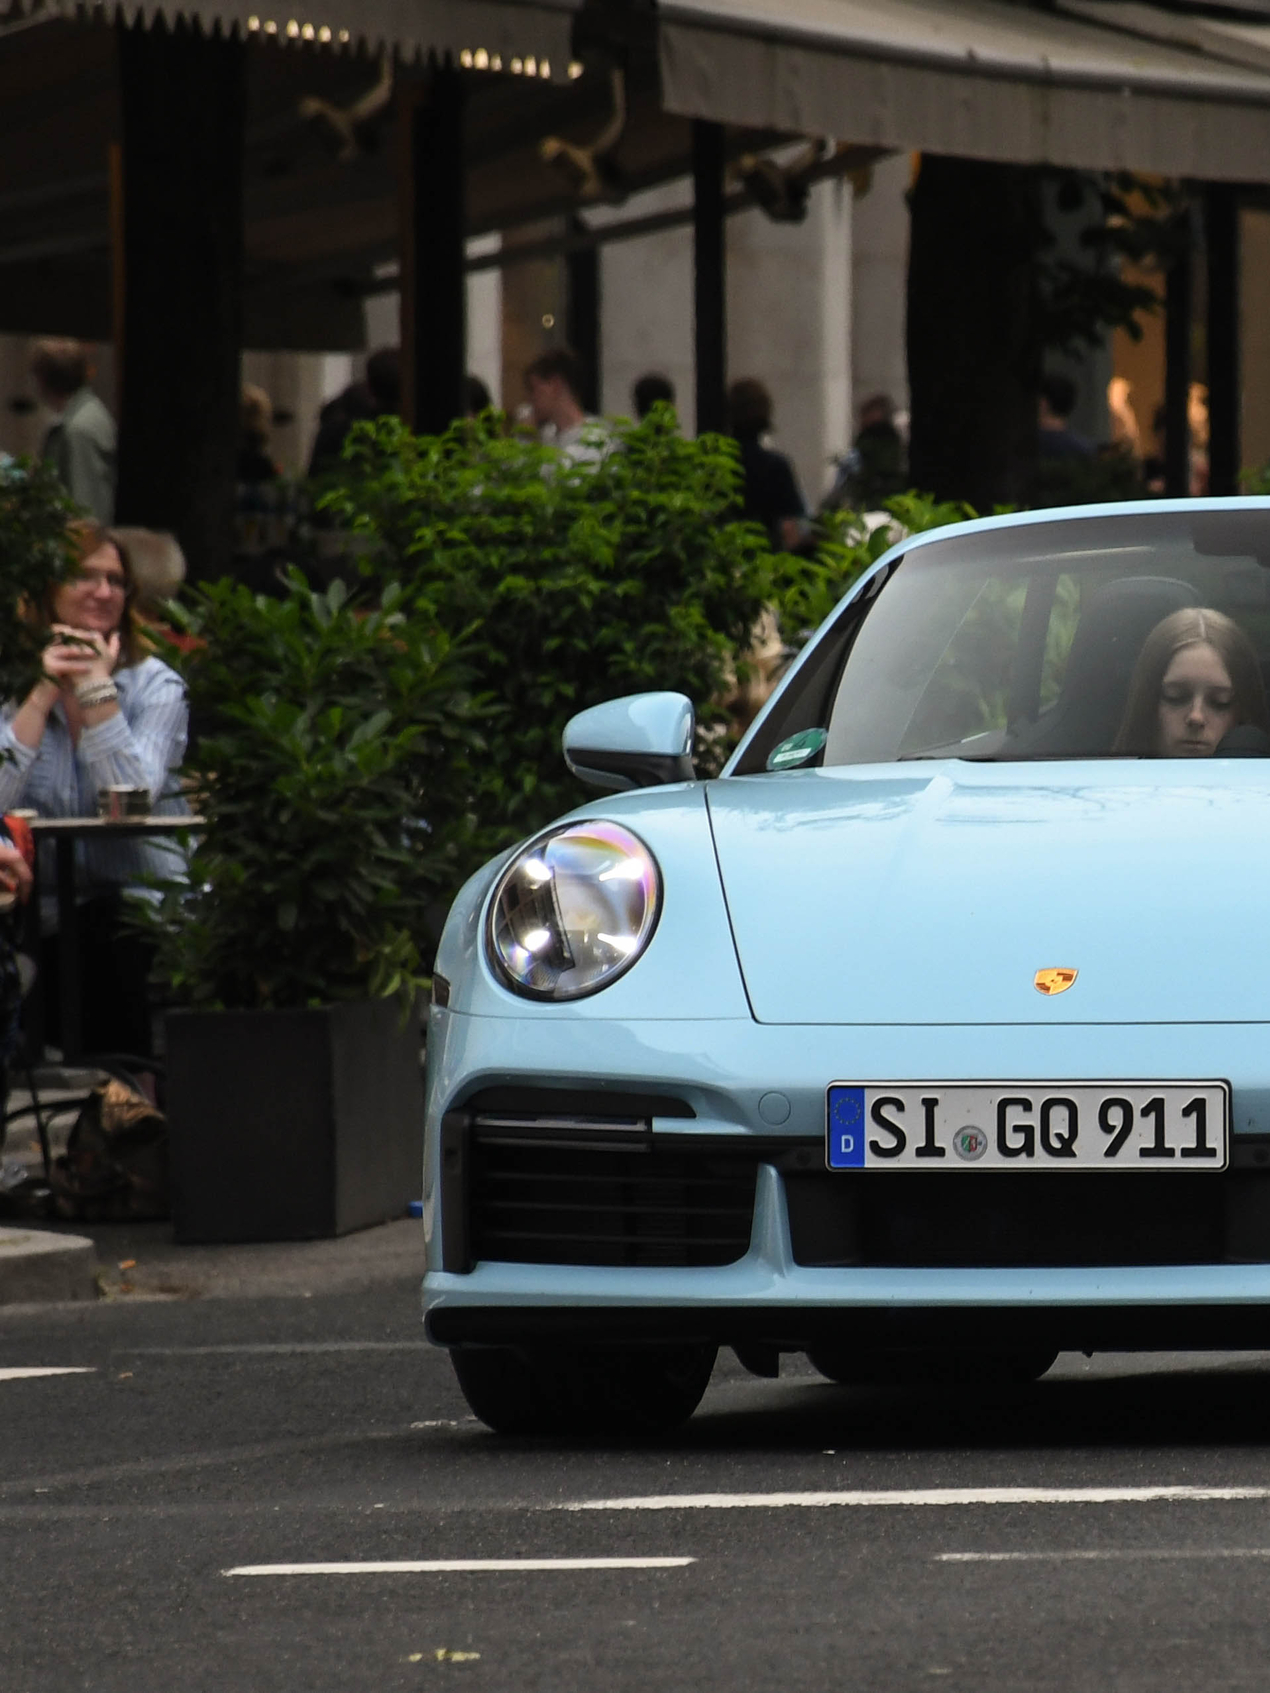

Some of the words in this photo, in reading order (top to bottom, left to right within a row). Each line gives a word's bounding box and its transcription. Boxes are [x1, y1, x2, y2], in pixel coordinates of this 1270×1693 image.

[841, 1135, 854, 1153] D
[869, 1096, 946, 1159] SI
[996, 1097, 1079, 1158] GQ
[1098, 1097, 1217, 1159] 911
